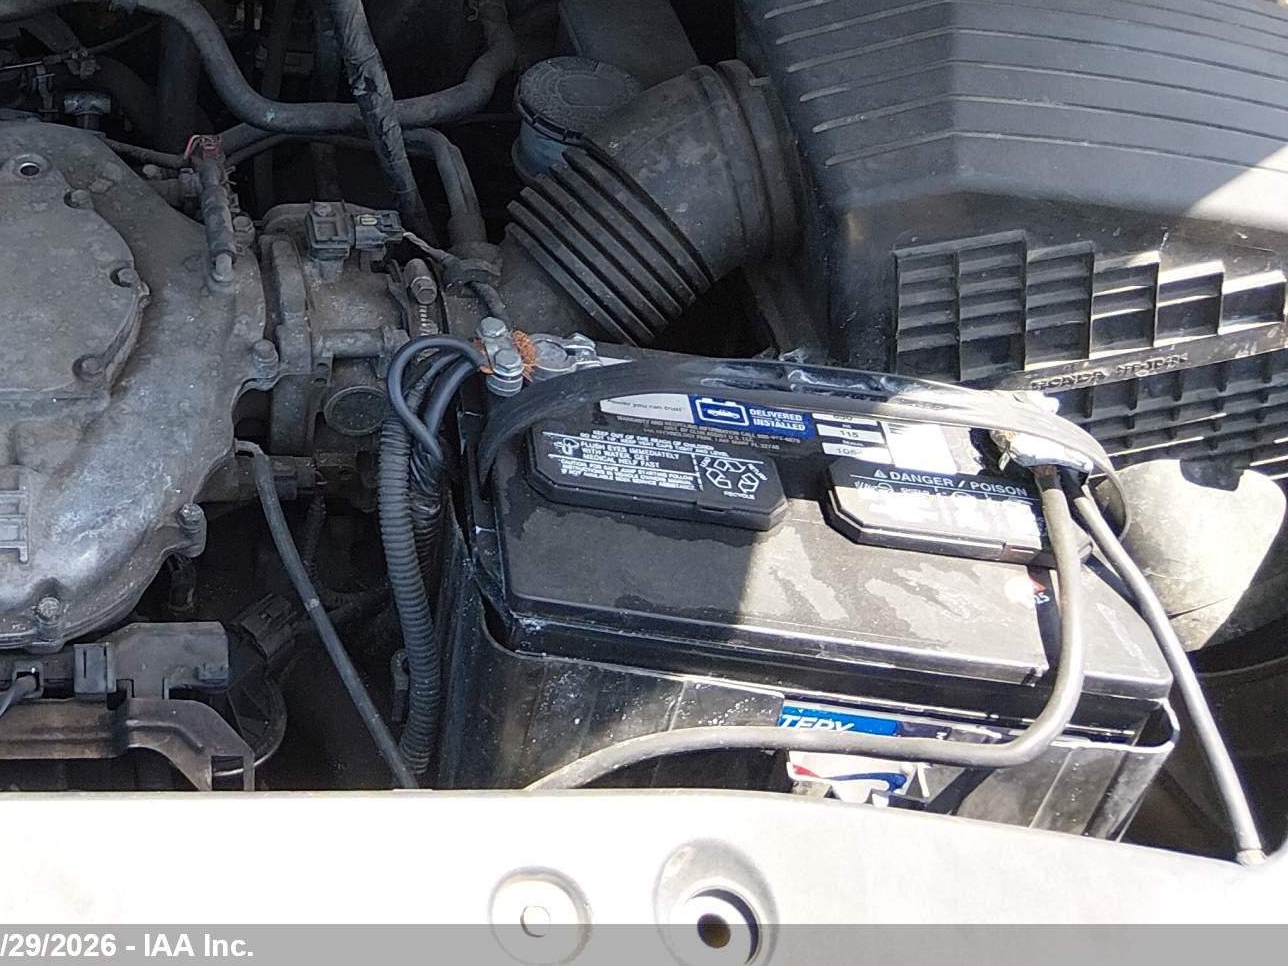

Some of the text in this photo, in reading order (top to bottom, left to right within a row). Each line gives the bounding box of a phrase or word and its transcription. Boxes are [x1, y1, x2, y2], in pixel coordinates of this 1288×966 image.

[749, 408, 803, 421] DELIVERED
[753, 418, 806, 431] INSTALLED
[580, 440, 679, 460] FLUSH EYES IMMEDIATELY
[582, 447, 602, 455] WITH
[582, 454, 659, 468] MEDICAL HELP FAST
[888, 470, 1028, 497] DANGER / POISON
